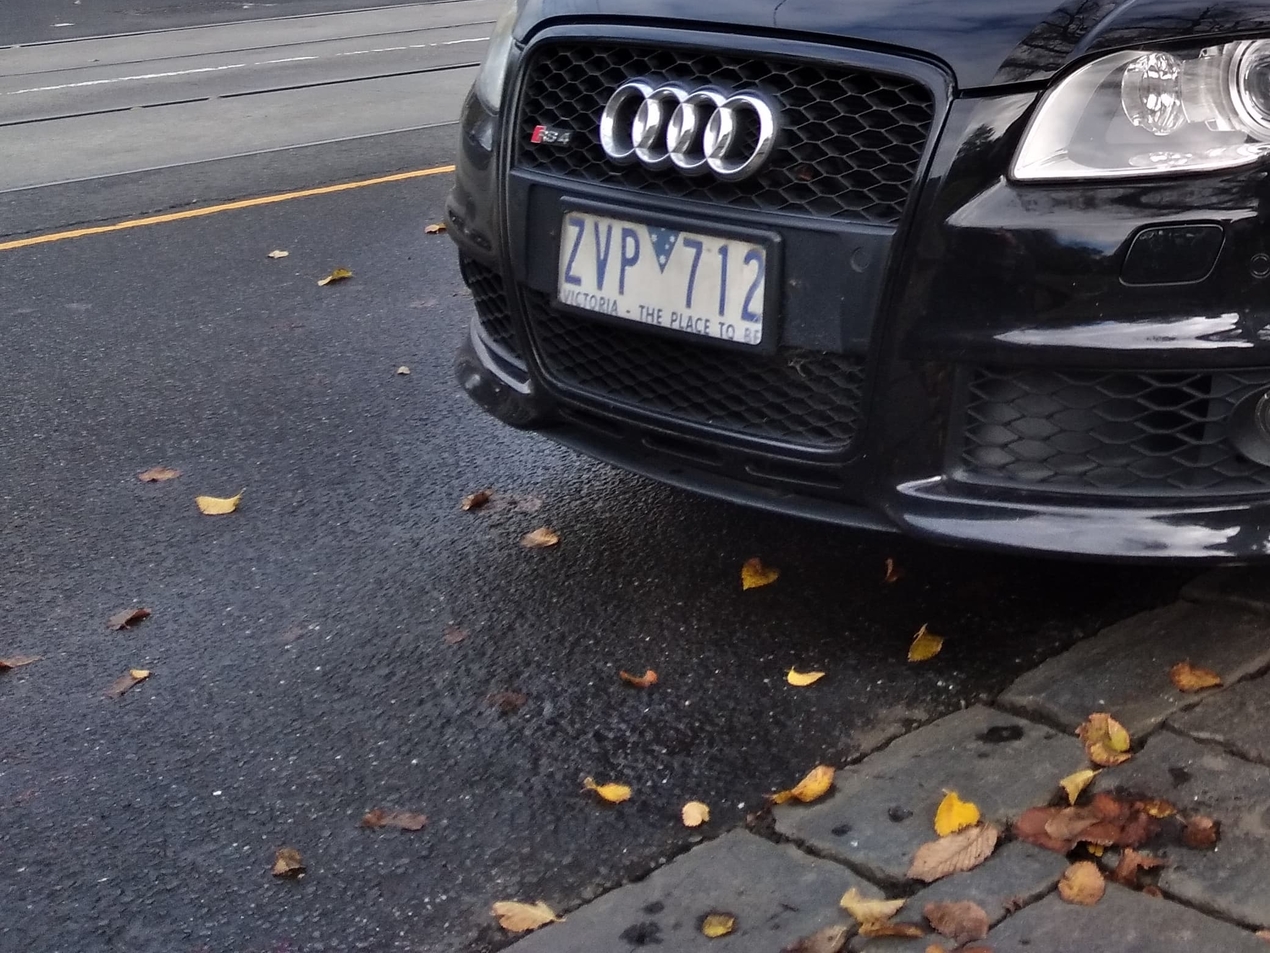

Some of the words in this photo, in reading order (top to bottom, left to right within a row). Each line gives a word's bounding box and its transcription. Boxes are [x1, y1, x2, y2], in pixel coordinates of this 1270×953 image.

[564, 216, 641, 296] ZVP
[683, 237, 766, 324] 712
[562, 289, 619, 315] VICTORIA
[638, 304, 663, 325] THE
[670, 311, 710, 335] PLACE
[718, 321, 735, 340] TO
